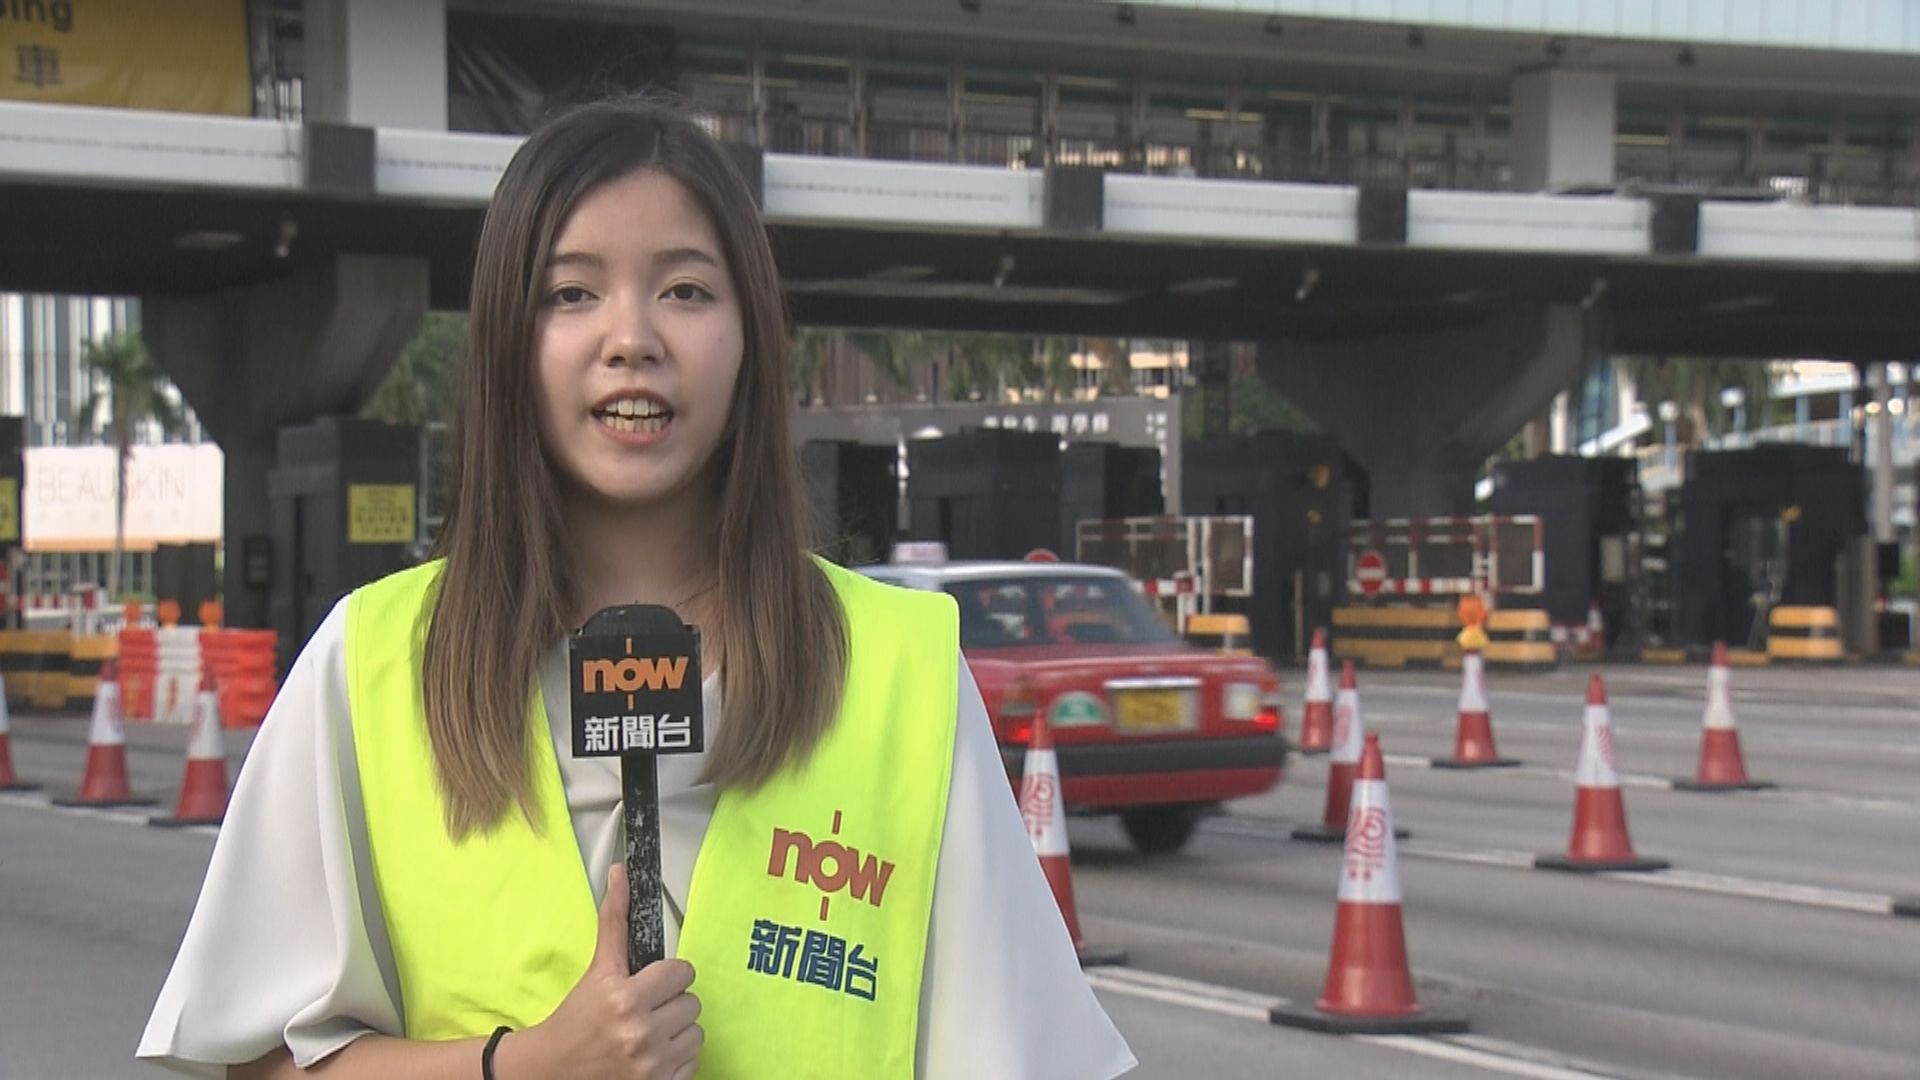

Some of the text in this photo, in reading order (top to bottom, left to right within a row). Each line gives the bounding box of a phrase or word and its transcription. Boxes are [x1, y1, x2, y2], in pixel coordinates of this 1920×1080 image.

[0, 0, 73, 32] ing
[583, 656, 689, 693] now
[584, 714, 691, 751] 新聞台
[768, 826, 895, 907] now
[747, 918, 878, 1001] 新聞台
